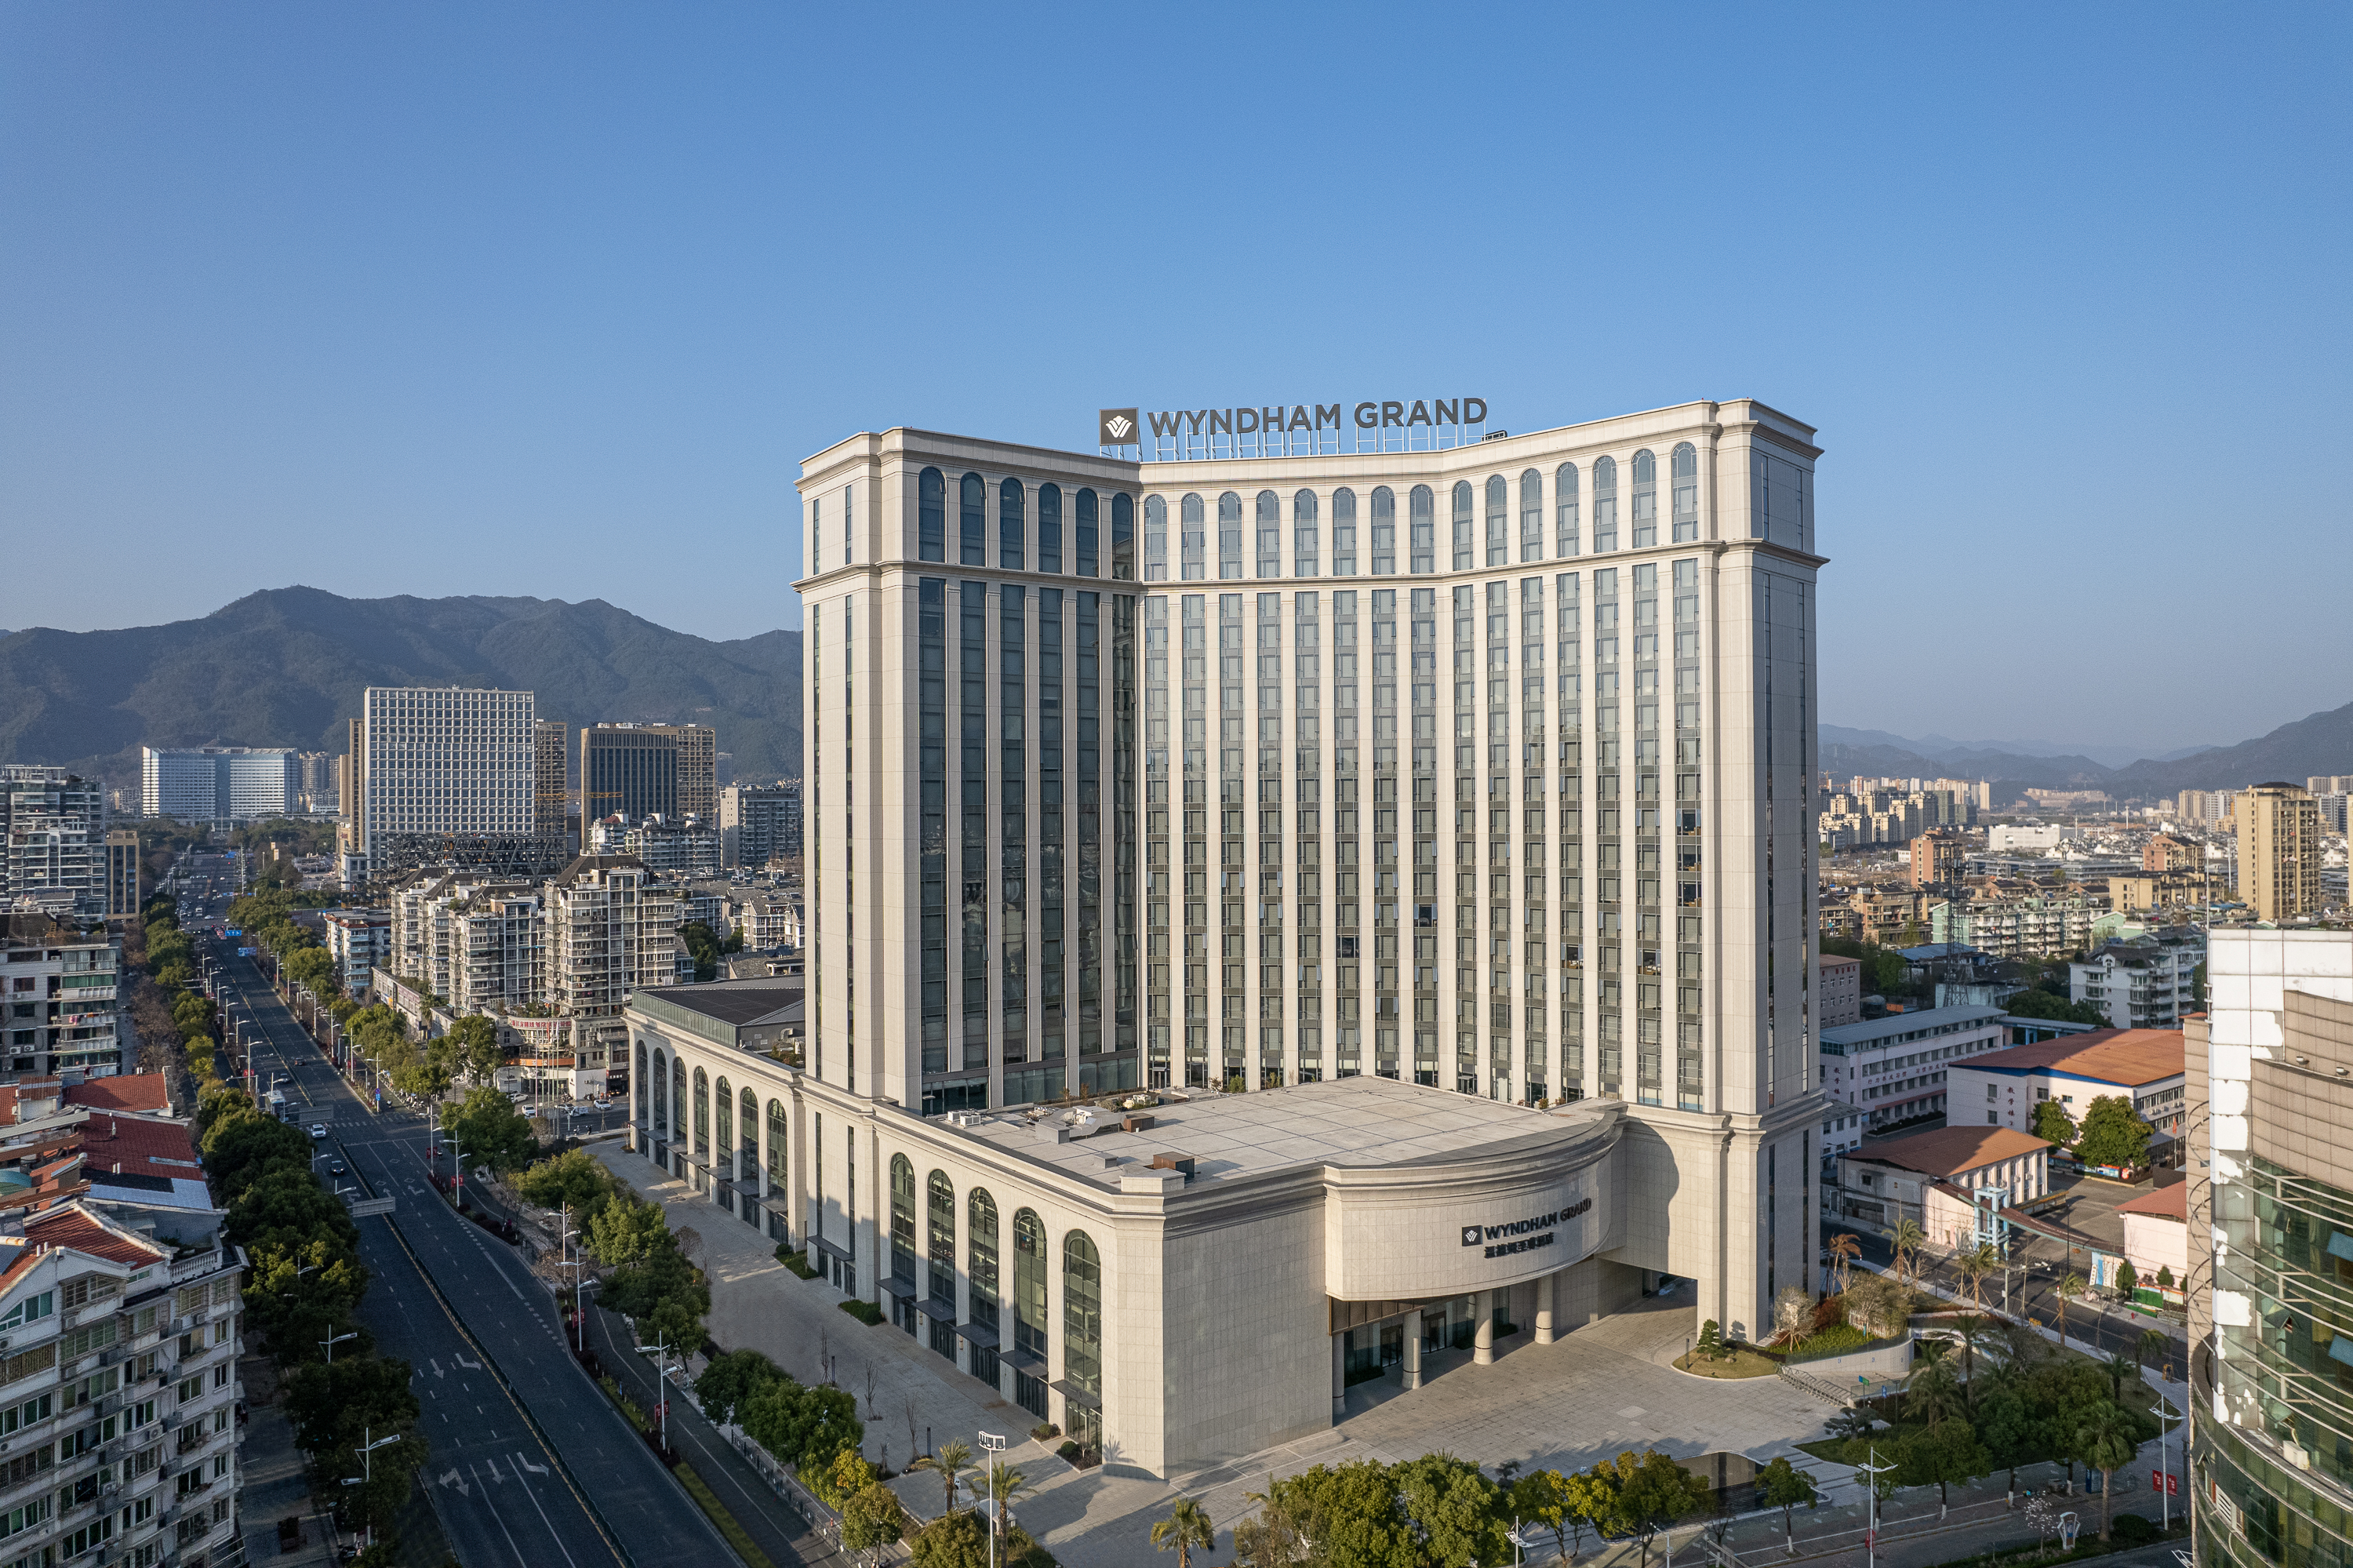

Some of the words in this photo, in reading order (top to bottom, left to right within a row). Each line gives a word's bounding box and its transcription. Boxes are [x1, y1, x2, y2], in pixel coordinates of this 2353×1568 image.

[1147, 403, 1340, 437] WYNDHAM
[1355, 397, 1488, 428] GRAND
[1484, 1211, 1558, 1240] WYNDHAM
[1560, 1197, 1592, 1222] GRAND
